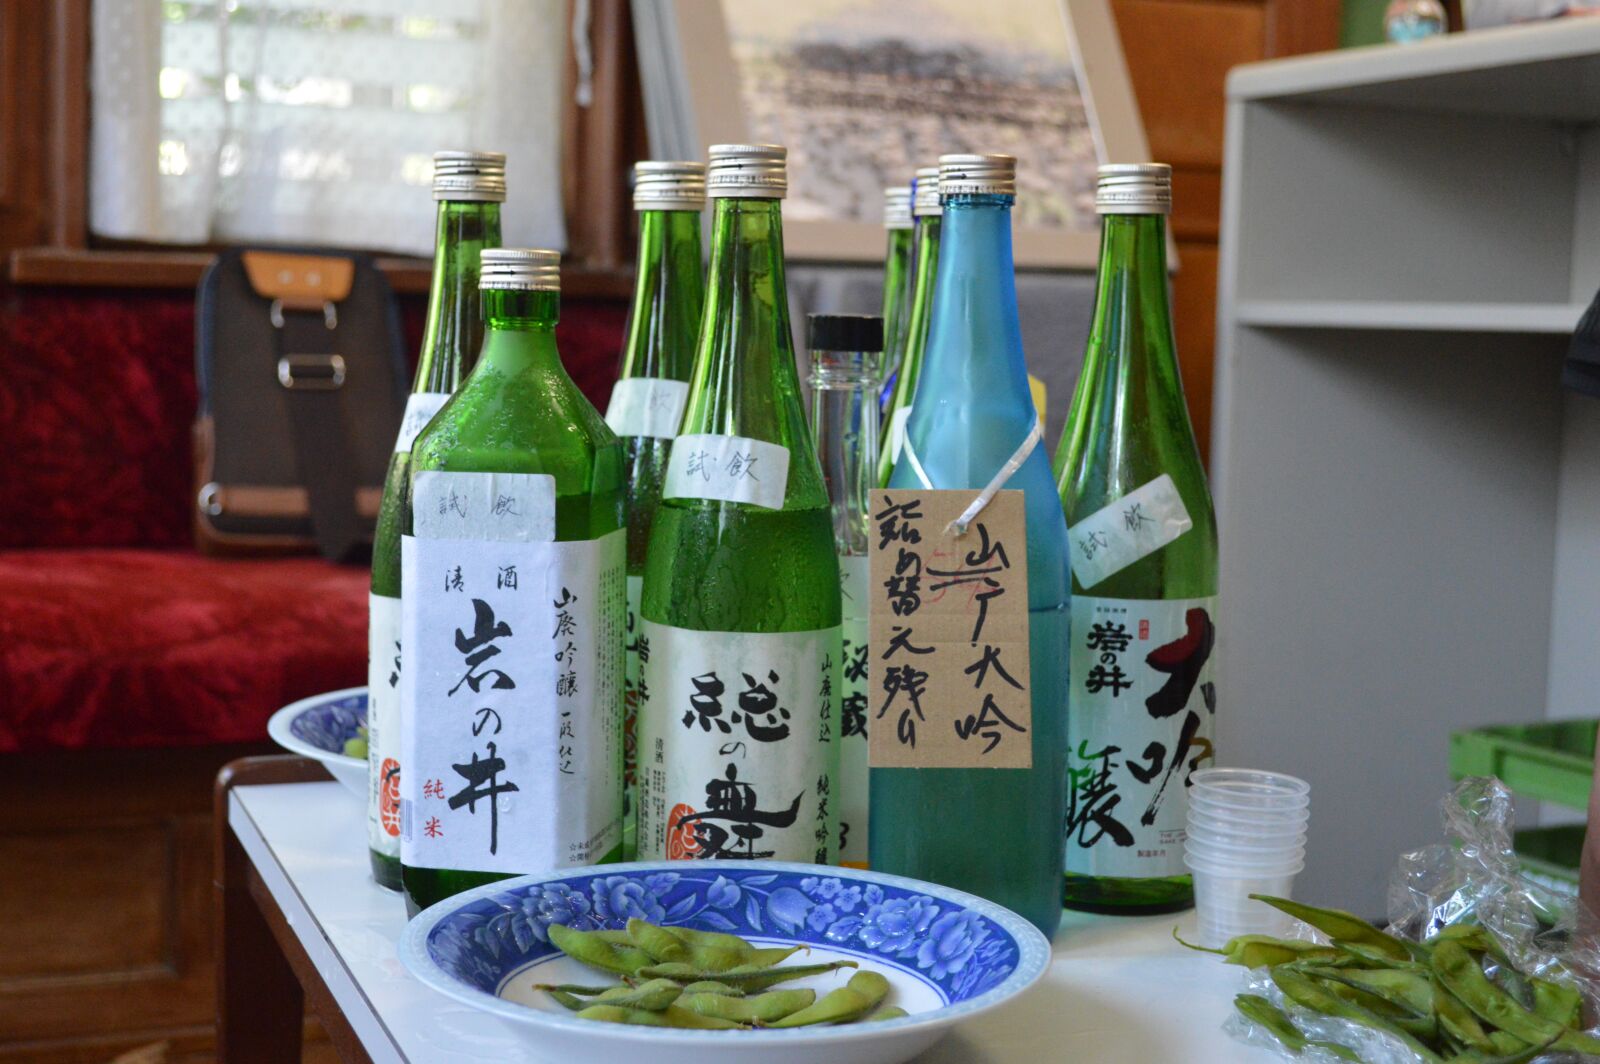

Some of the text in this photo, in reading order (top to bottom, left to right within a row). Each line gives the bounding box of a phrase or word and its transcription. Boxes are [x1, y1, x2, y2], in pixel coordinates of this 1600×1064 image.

[686, 450, 761, 483] 試飲
[444, 566, 518, 593] 清酒
[447, 598, 519, 857] 岩の井
[422, 779, 446, 838] 純米
